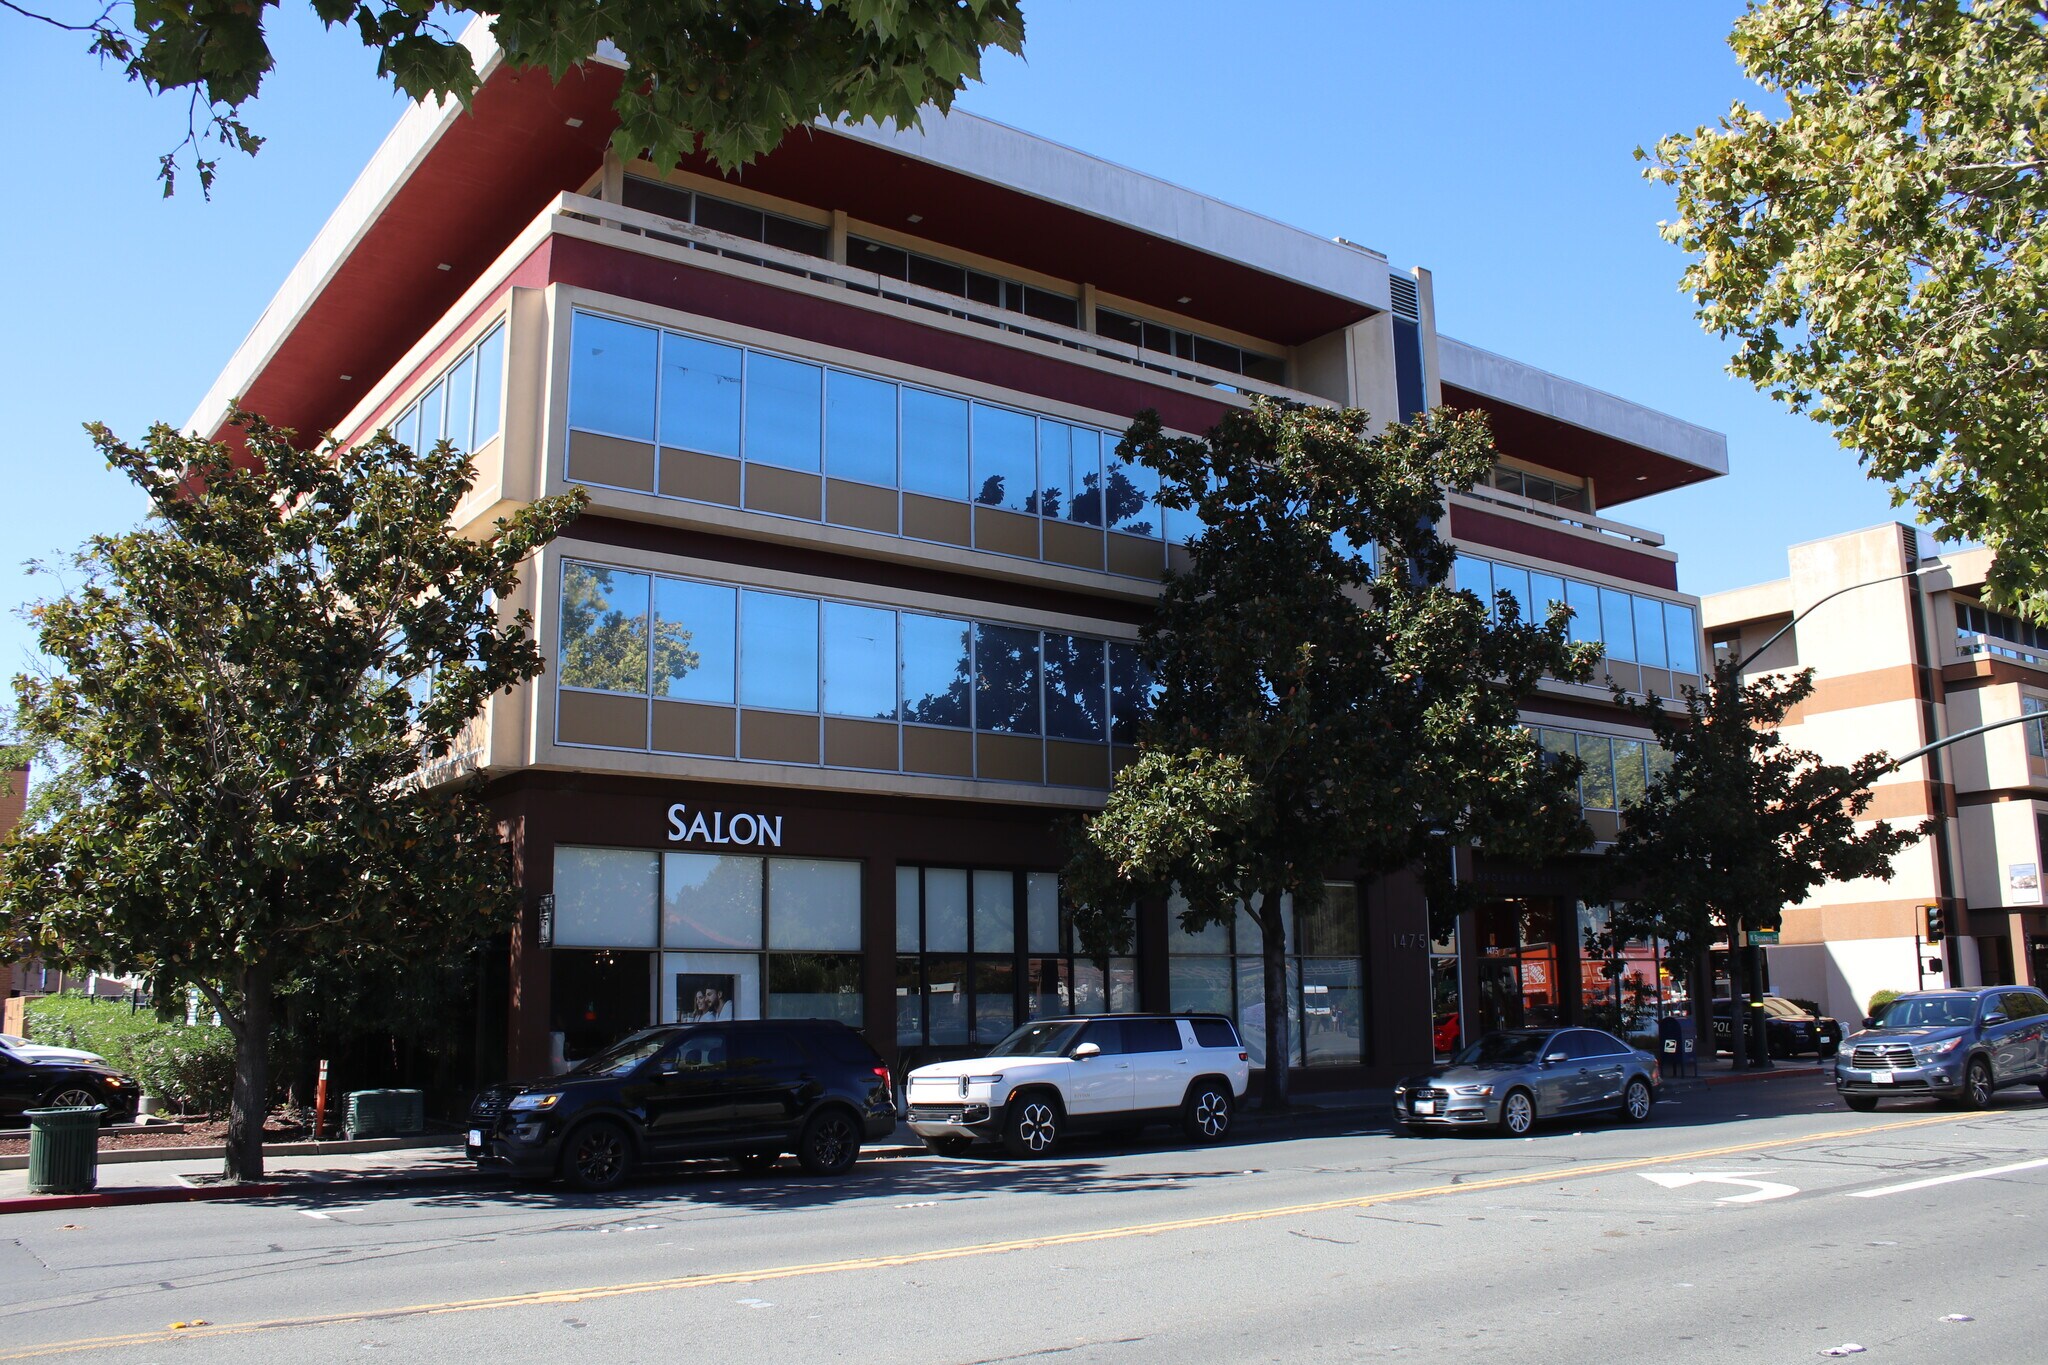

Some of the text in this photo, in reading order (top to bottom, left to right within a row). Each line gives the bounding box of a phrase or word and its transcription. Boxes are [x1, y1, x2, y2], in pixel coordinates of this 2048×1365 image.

[667, 803, 783, 847] SALON
[1393, 932, 1426, 949] 1475
[1486, 946, 1499, 955] 1475
[1713, 1021, 1748, 1034] POLE
